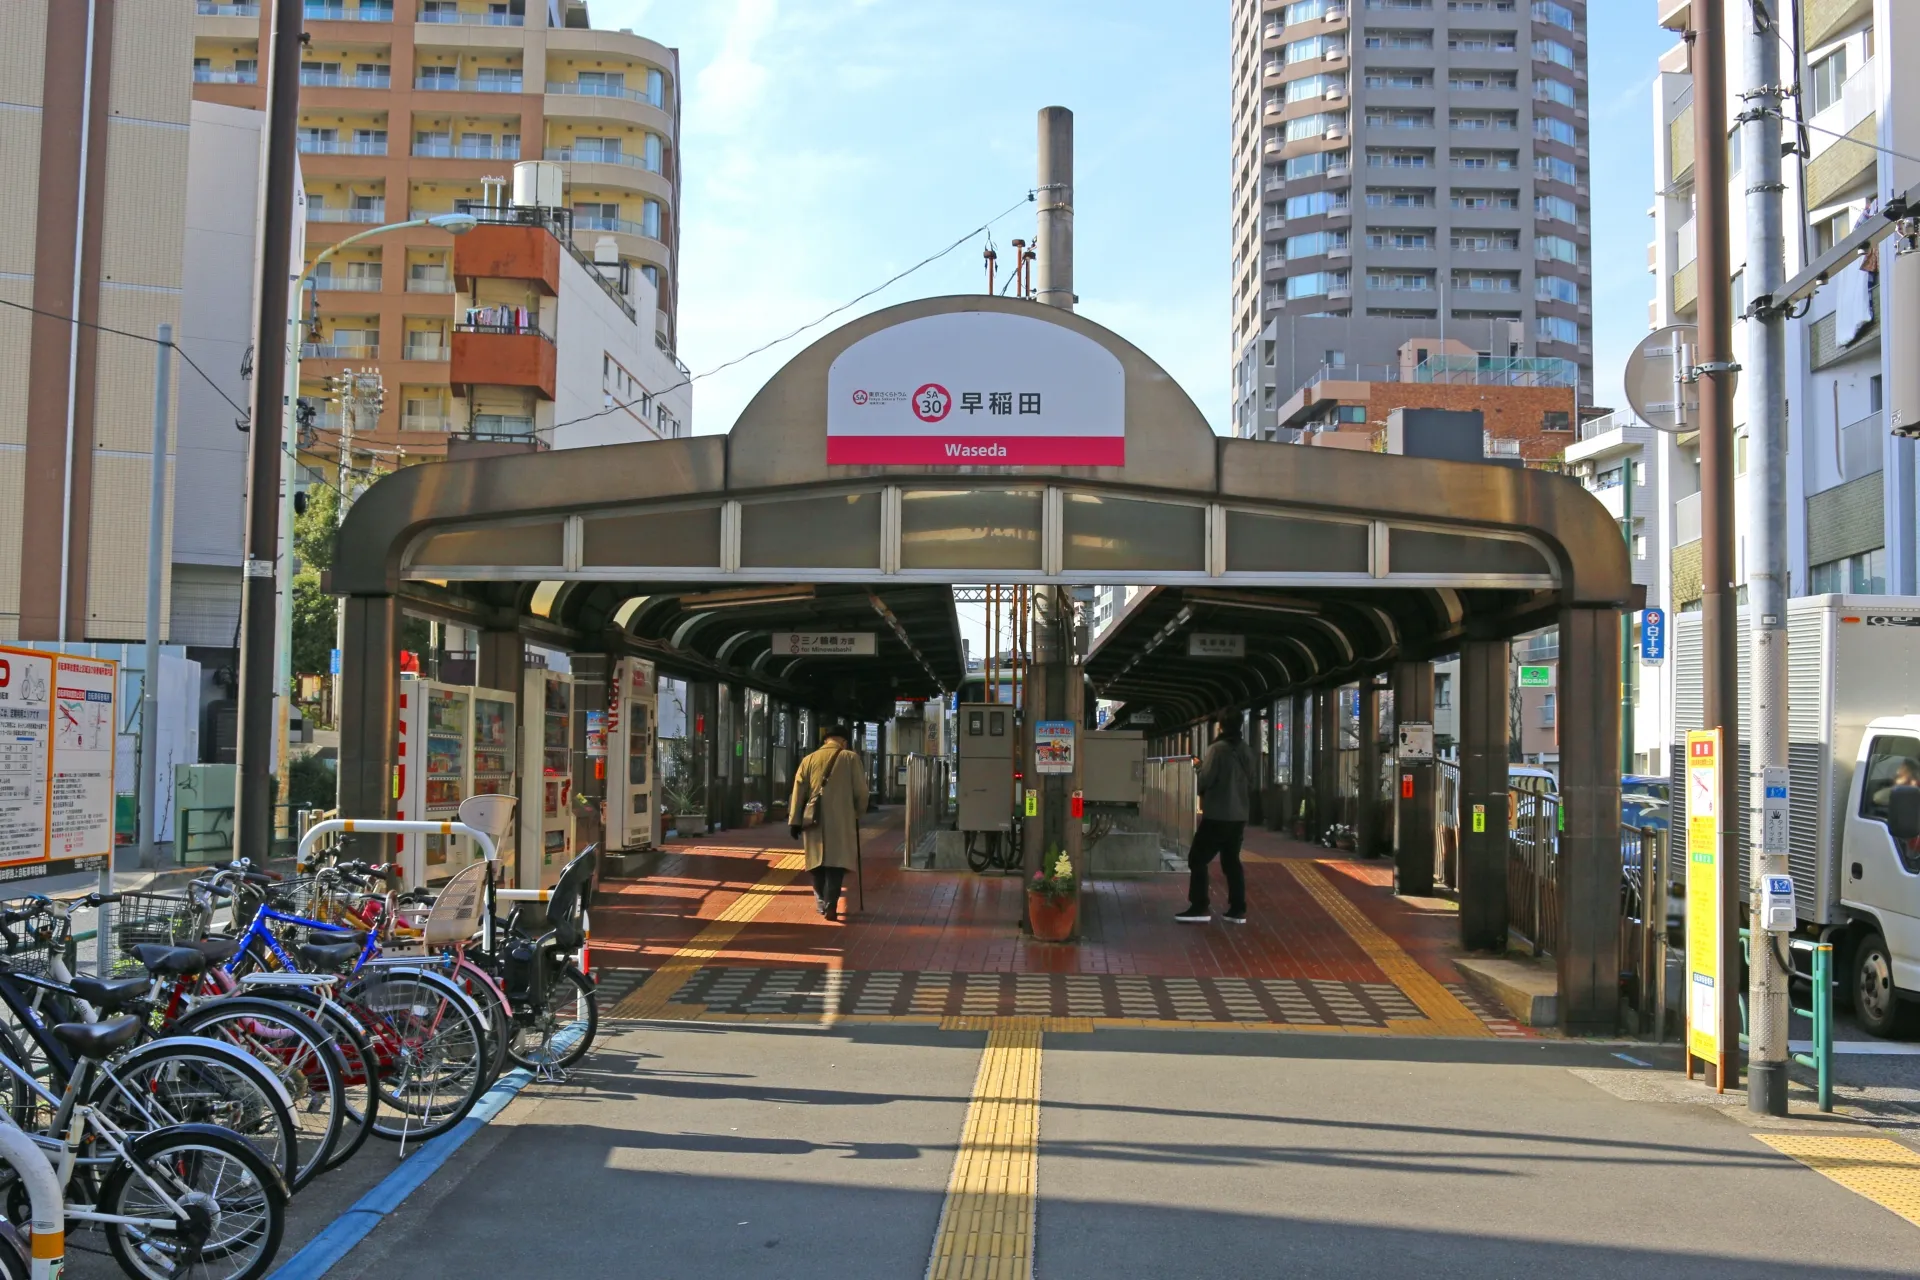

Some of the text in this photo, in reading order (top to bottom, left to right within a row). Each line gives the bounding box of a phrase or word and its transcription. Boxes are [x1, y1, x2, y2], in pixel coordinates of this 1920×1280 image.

[926, 390, 938, 399] SA
[921, 400, 942, 414] 30
[960, 392, 1041, 415] 早稲田
[944, 442, 1007, 457] Waseda
[1646, 625, 1660, 658] 白十字
